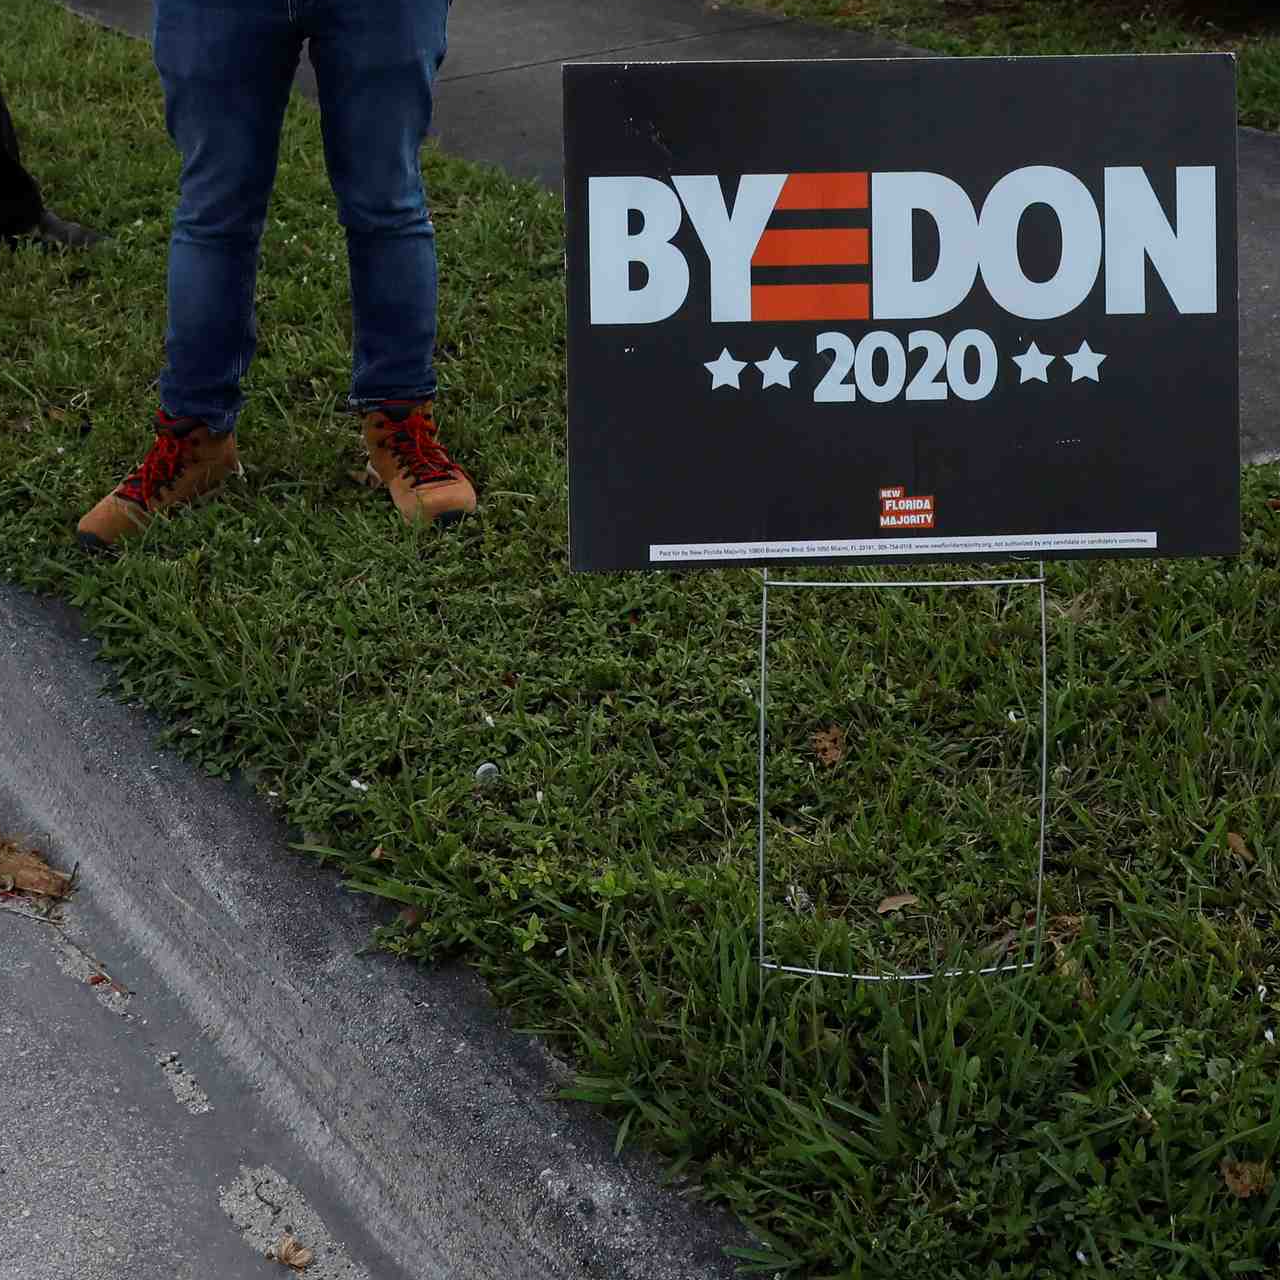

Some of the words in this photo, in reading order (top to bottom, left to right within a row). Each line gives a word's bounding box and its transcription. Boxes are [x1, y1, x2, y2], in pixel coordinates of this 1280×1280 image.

[813, 328, 999, 404] 2020
[881, 489, 901, 498] NEW
[885, 499, 931, 511] FLORIDA
[880, 514, 933, 527] MAJORITY
